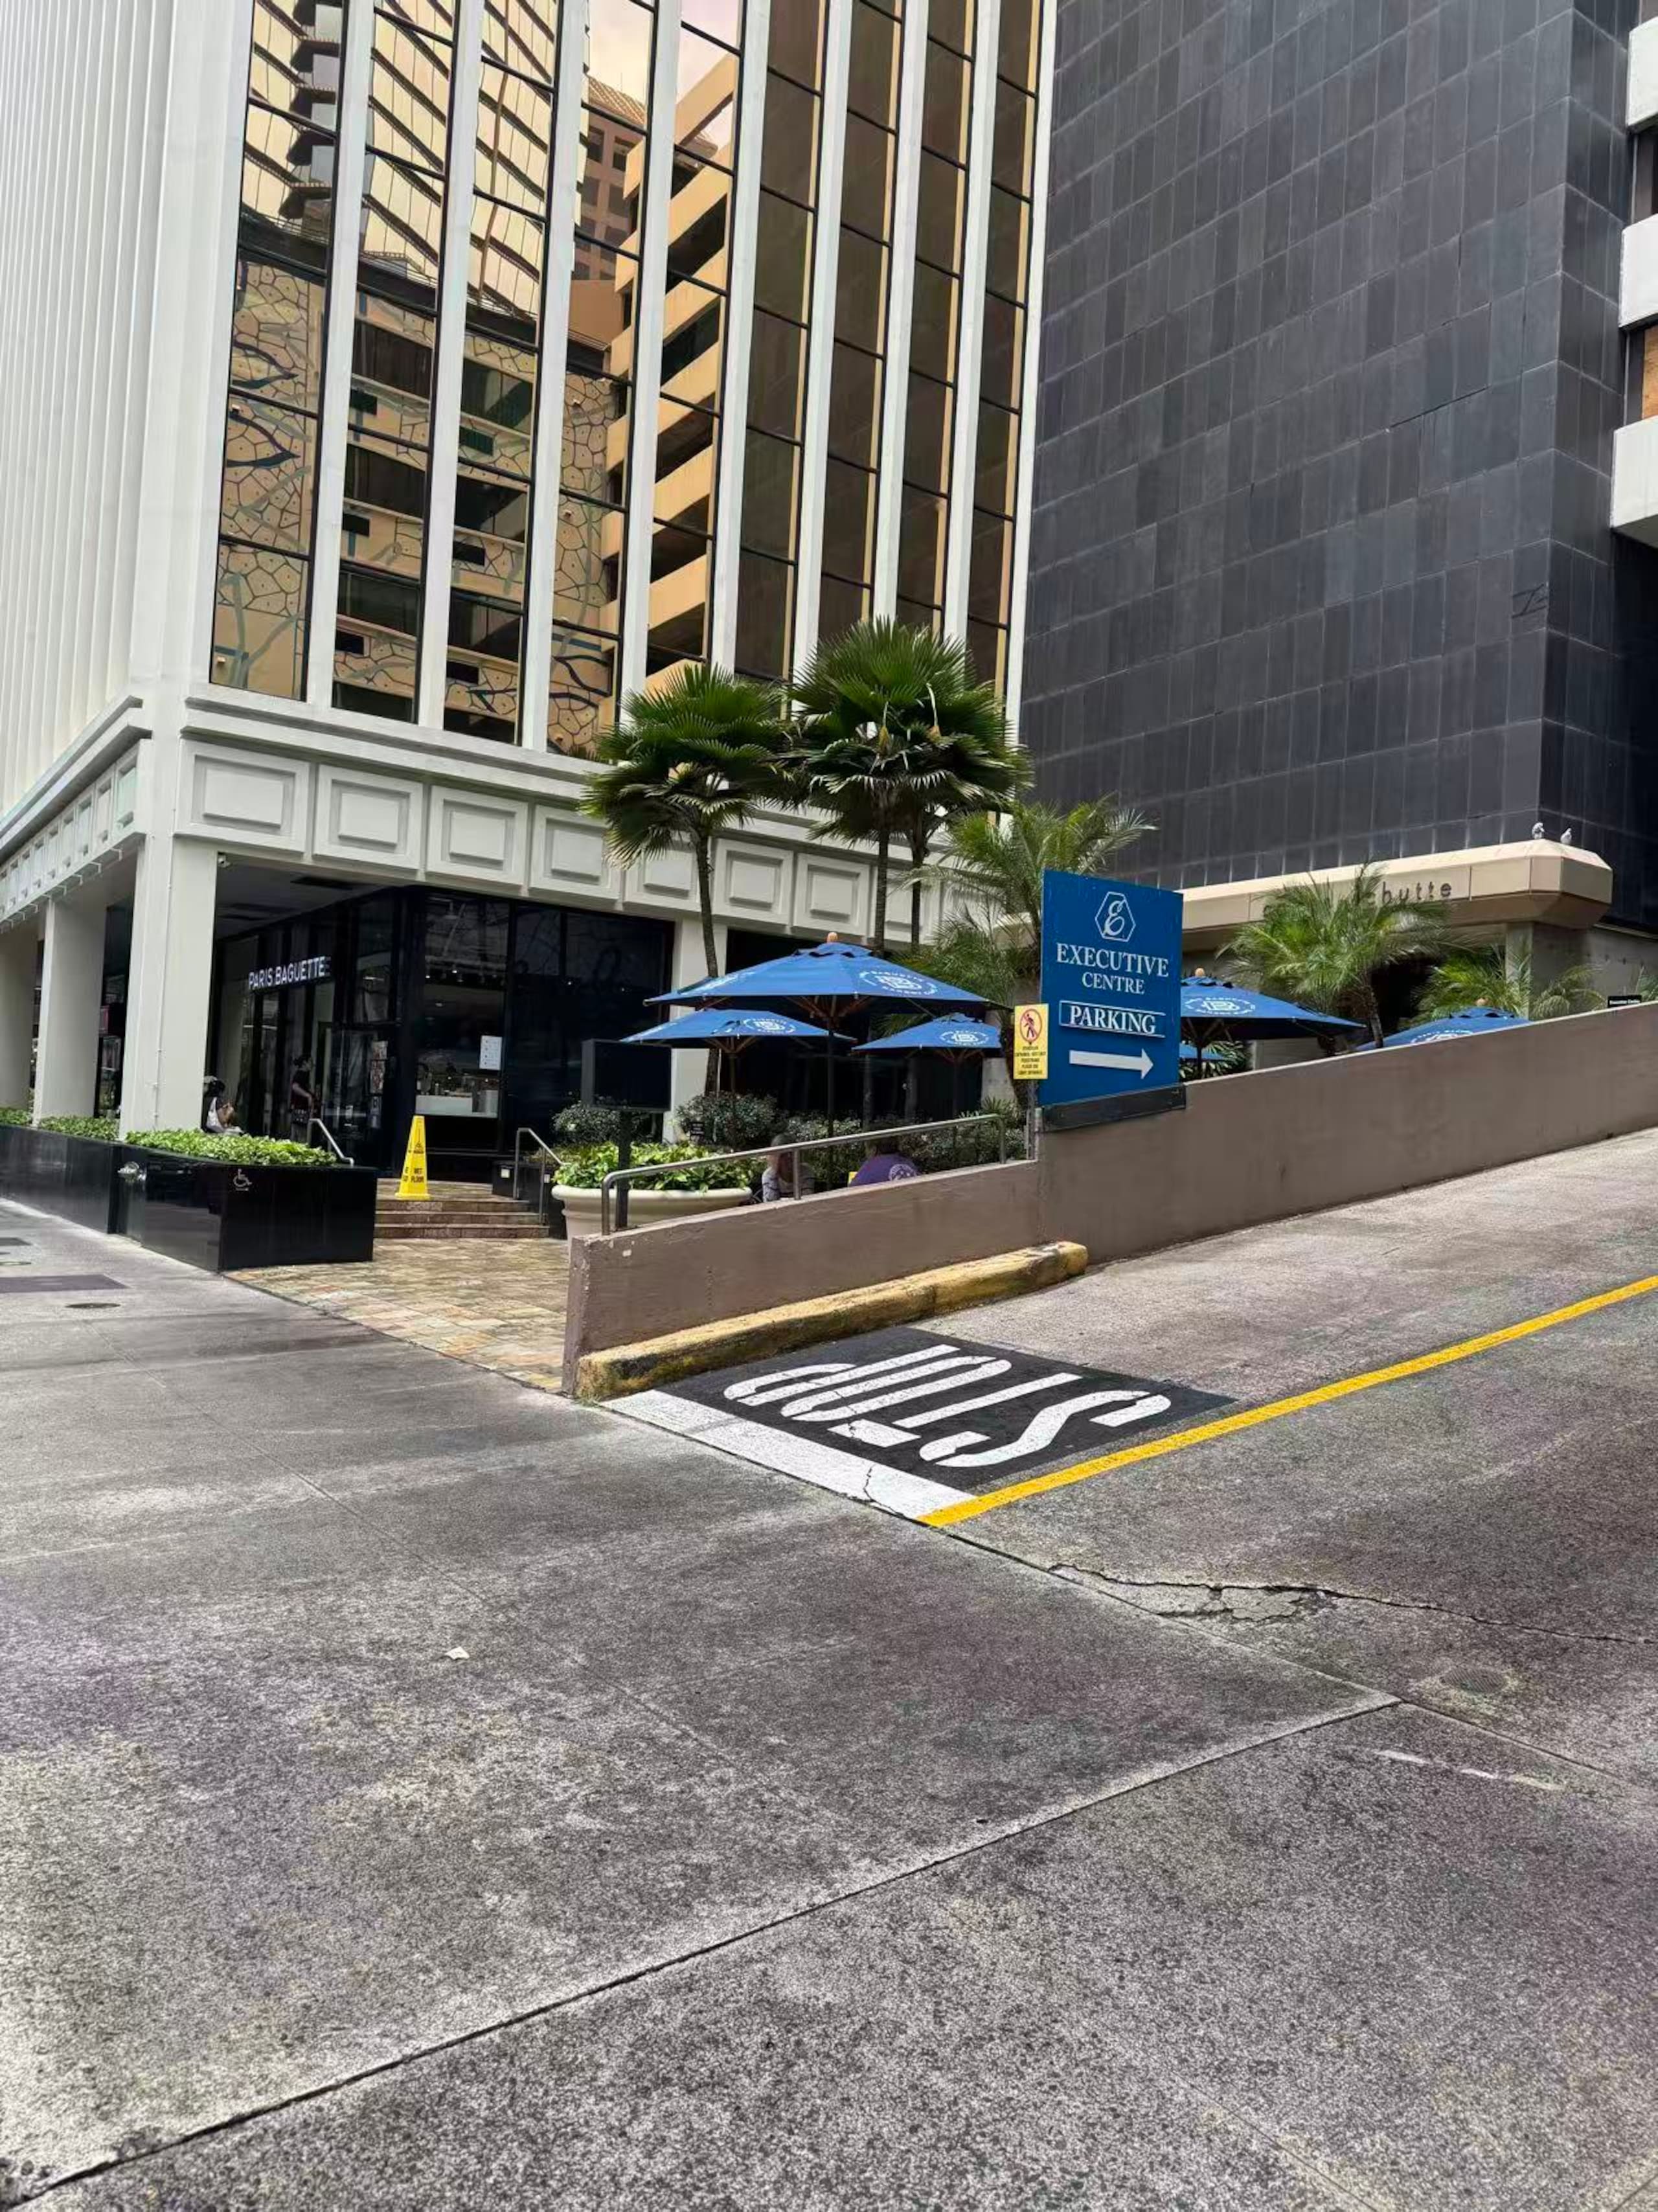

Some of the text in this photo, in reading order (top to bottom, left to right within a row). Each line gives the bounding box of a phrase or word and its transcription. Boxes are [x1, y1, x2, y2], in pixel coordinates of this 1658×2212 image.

[249, 956, 326, 990] PARIS BAGUETTE
[1056, 942, 1169, 977] EXECUTIVE
[1082, 972, 1145, 995] CENTRE
[1070, 1005, 1157, 1034] PARKING
[723, 1343, 1172, 1468] STOP
